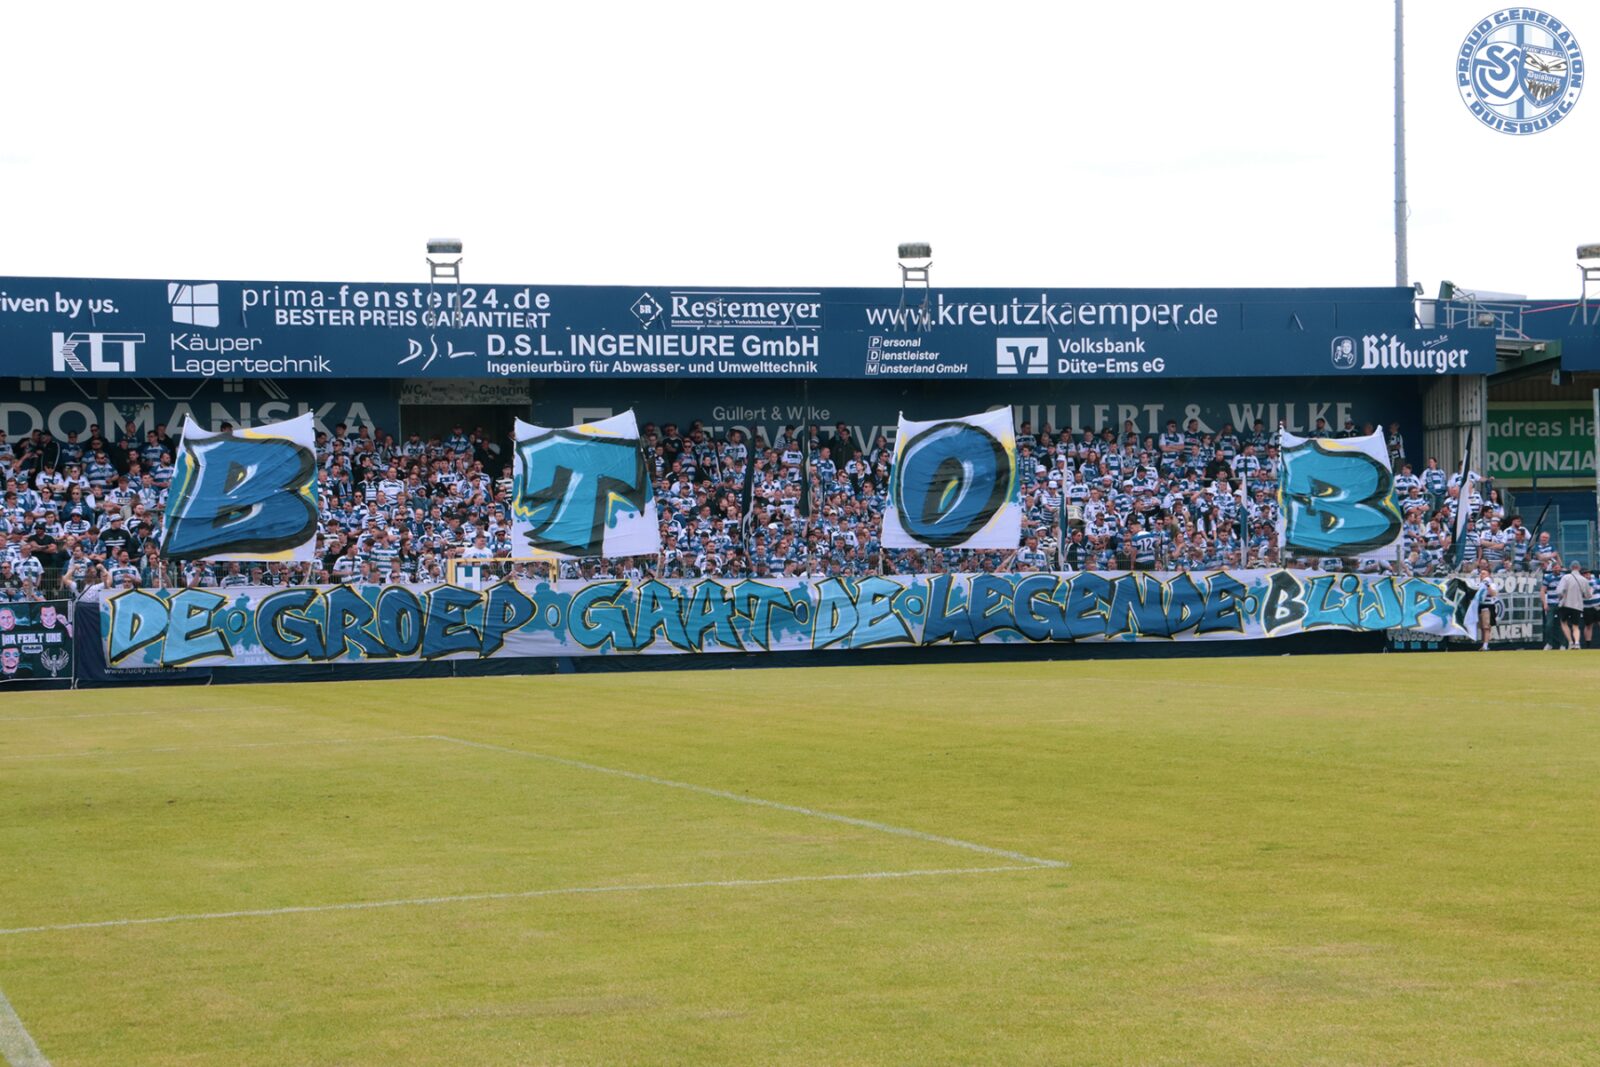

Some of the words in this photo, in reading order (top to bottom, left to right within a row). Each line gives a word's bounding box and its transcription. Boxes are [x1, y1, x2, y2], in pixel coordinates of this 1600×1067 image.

[0, 291, 49, 312] iven
[55, 291, 82, 318] by
[88, 299, 119, 313] us.
[242, 285, 550, 311] prima-fenster24.de
[275, 309, 355, 326] BESTER
[360, 310, 417, 327] PREIS
[422, 311, 550, 328] GARANTIERT
[671, 296, 821, 325] Restemeyer
[866, 293, 1218, 332] www.kreutzkaemper.de
[52, 332, 145, 372] KLT
[171, 333, 262, 354] Käuper
[487, 334, 563, 356] D.S.L.
[571, 334, 735, 356] INGENIEURE
[741, 335, 819, 357] GmbH
[871, 337, 921, 347] Personal
[1058, 337, 1145, 353] Volksbank
[870, 350, 940, 360] Dienstleister
[1361, 333, 1469, 374] Bitburger
[171, 355, 332, 376] Lagertechnik
[487, 361, 585, 375] Ingenieurbüro
[589, 361, 609, 373] für
[612, 361, 685, 373] Abwasser-
[688, 361, 714, 373] und
[718, 361, 817, 373] Umwelttechnik
[867, 364, 934, 374] Münsterland
[936, 364, 968, 374] GmbH
[1058, 358, 1138, 374] Düte-Ems
[1142, 357, 1165, 373] eG
[401, 384, 422, 395] WC
[0, 402, 377, 443] DOMANSKA
[771, 406, 783, 420] &
[786, 406, 830, 420] Wlke
[986, 402, 1164, 436] ULLERT
[1182, 403, 1216, 434] &
[1228, 402, 1353, 434] WILKE
[1487, 416, 1562, 437] ndreas
[1570, 416, 1595, 437] Ha
[1487, 450, 1596, 472] ROVINZIA
[163, 431, 317, 560] B
[515, 429, 648, 558] T
[1281, 438, 1402, 555] B
[1140, 538, 1152, 552] 12
[1493, 576, 1537, 594] POTT
[106, 586, 235, 667] DE
[254, 581, 538, 662] GROEP
[568, 578, 796, 653] GAAT
[812, 574, 916, 650] DE
[921, 570, 1250, 648] LEGENDE
[1489, 623, 1533, 640] AKEN
